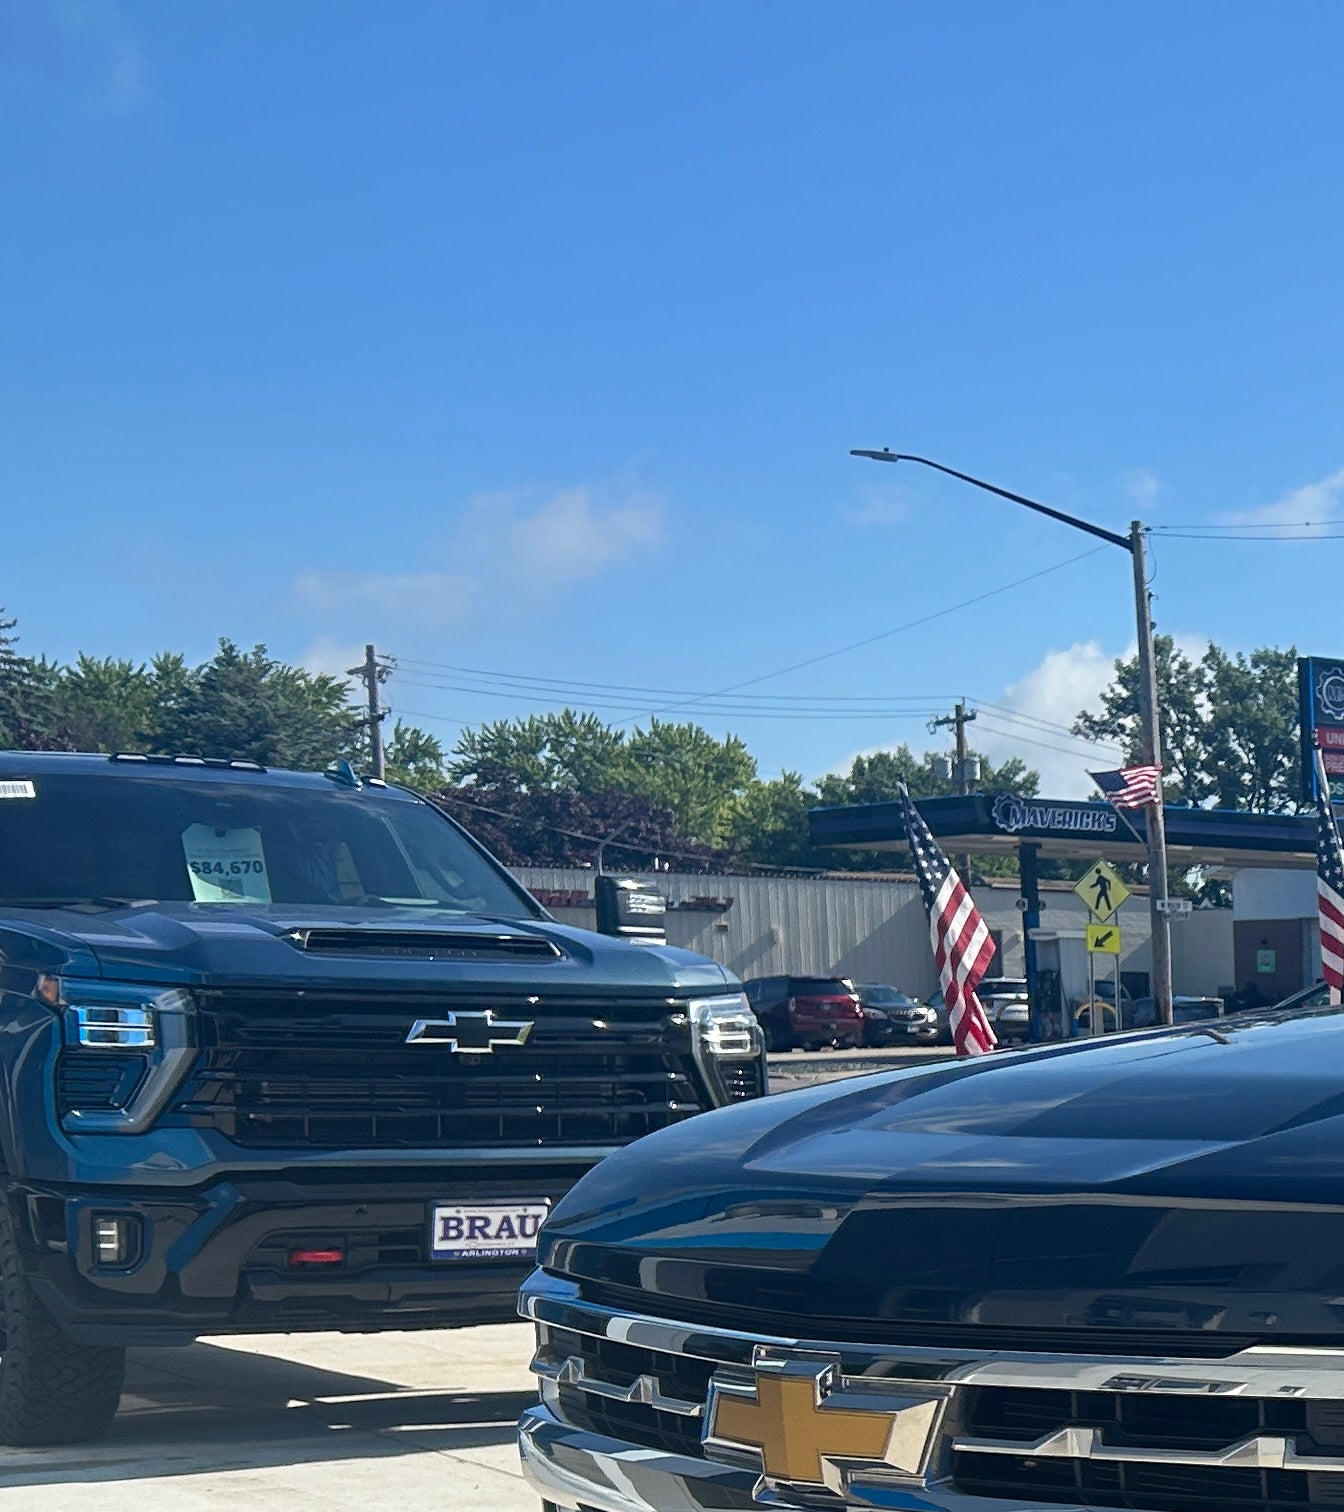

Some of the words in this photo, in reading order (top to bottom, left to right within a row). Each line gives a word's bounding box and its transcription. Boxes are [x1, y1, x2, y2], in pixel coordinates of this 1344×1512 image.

[190, 860, 264, 877] $84,670
[439, 1214, 542, 1241] BRAU
[461, 1249, 520, 1258] ARLINGTON
